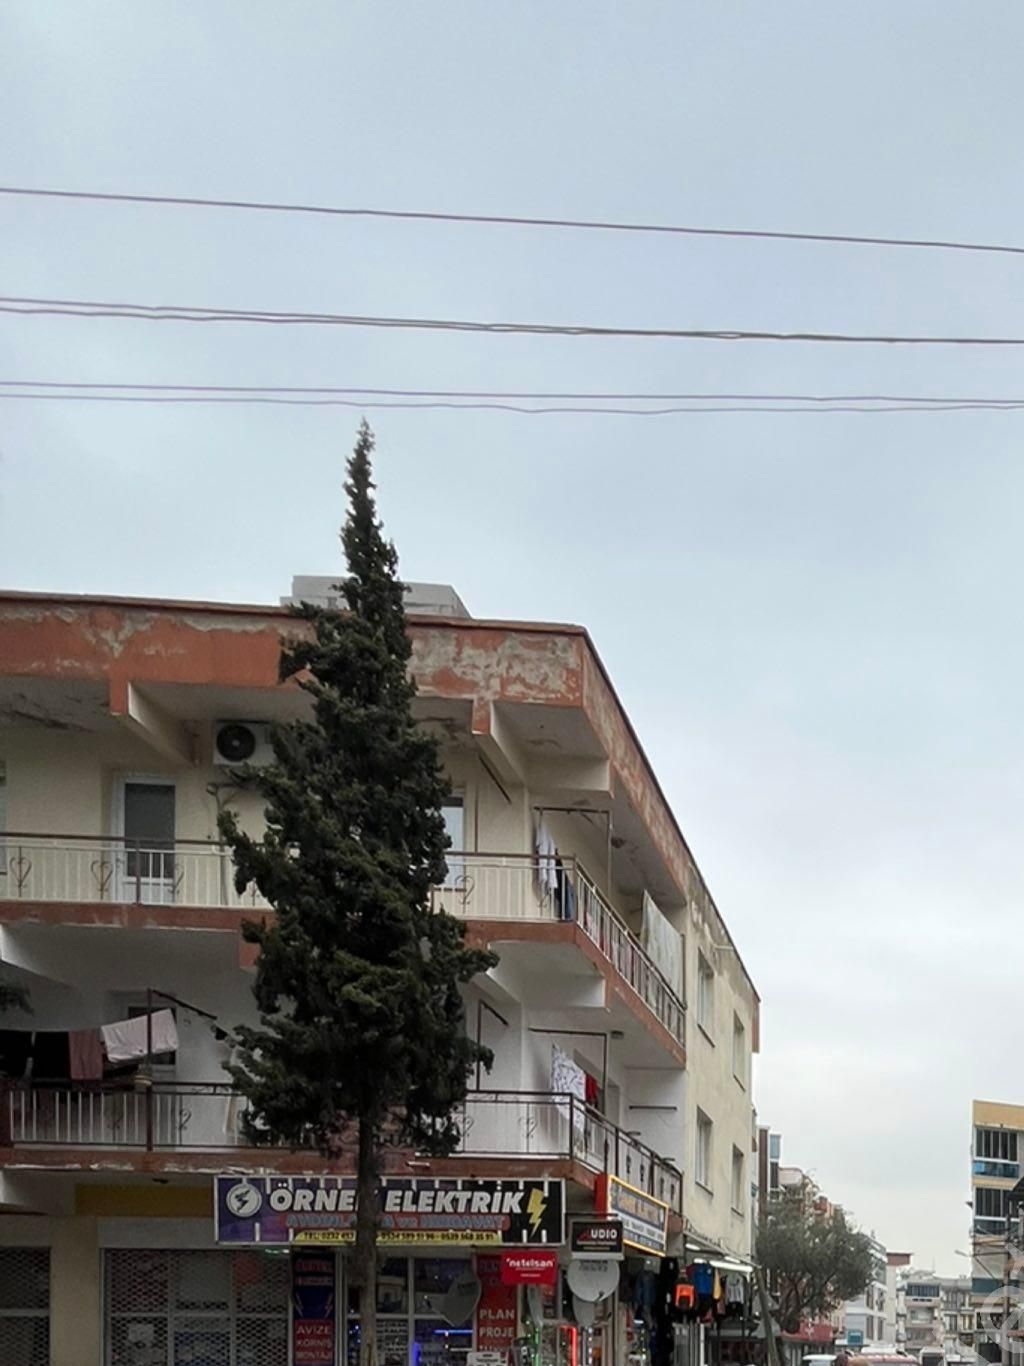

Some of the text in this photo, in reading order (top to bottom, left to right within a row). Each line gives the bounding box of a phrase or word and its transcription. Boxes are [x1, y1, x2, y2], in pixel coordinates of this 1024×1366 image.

[269, 1182, 525, 1213] ÖRNE ELEKTRİK
[479, 1308, 516, 1320] PLAN
[478, 1326, 514, 1338] PROJE
